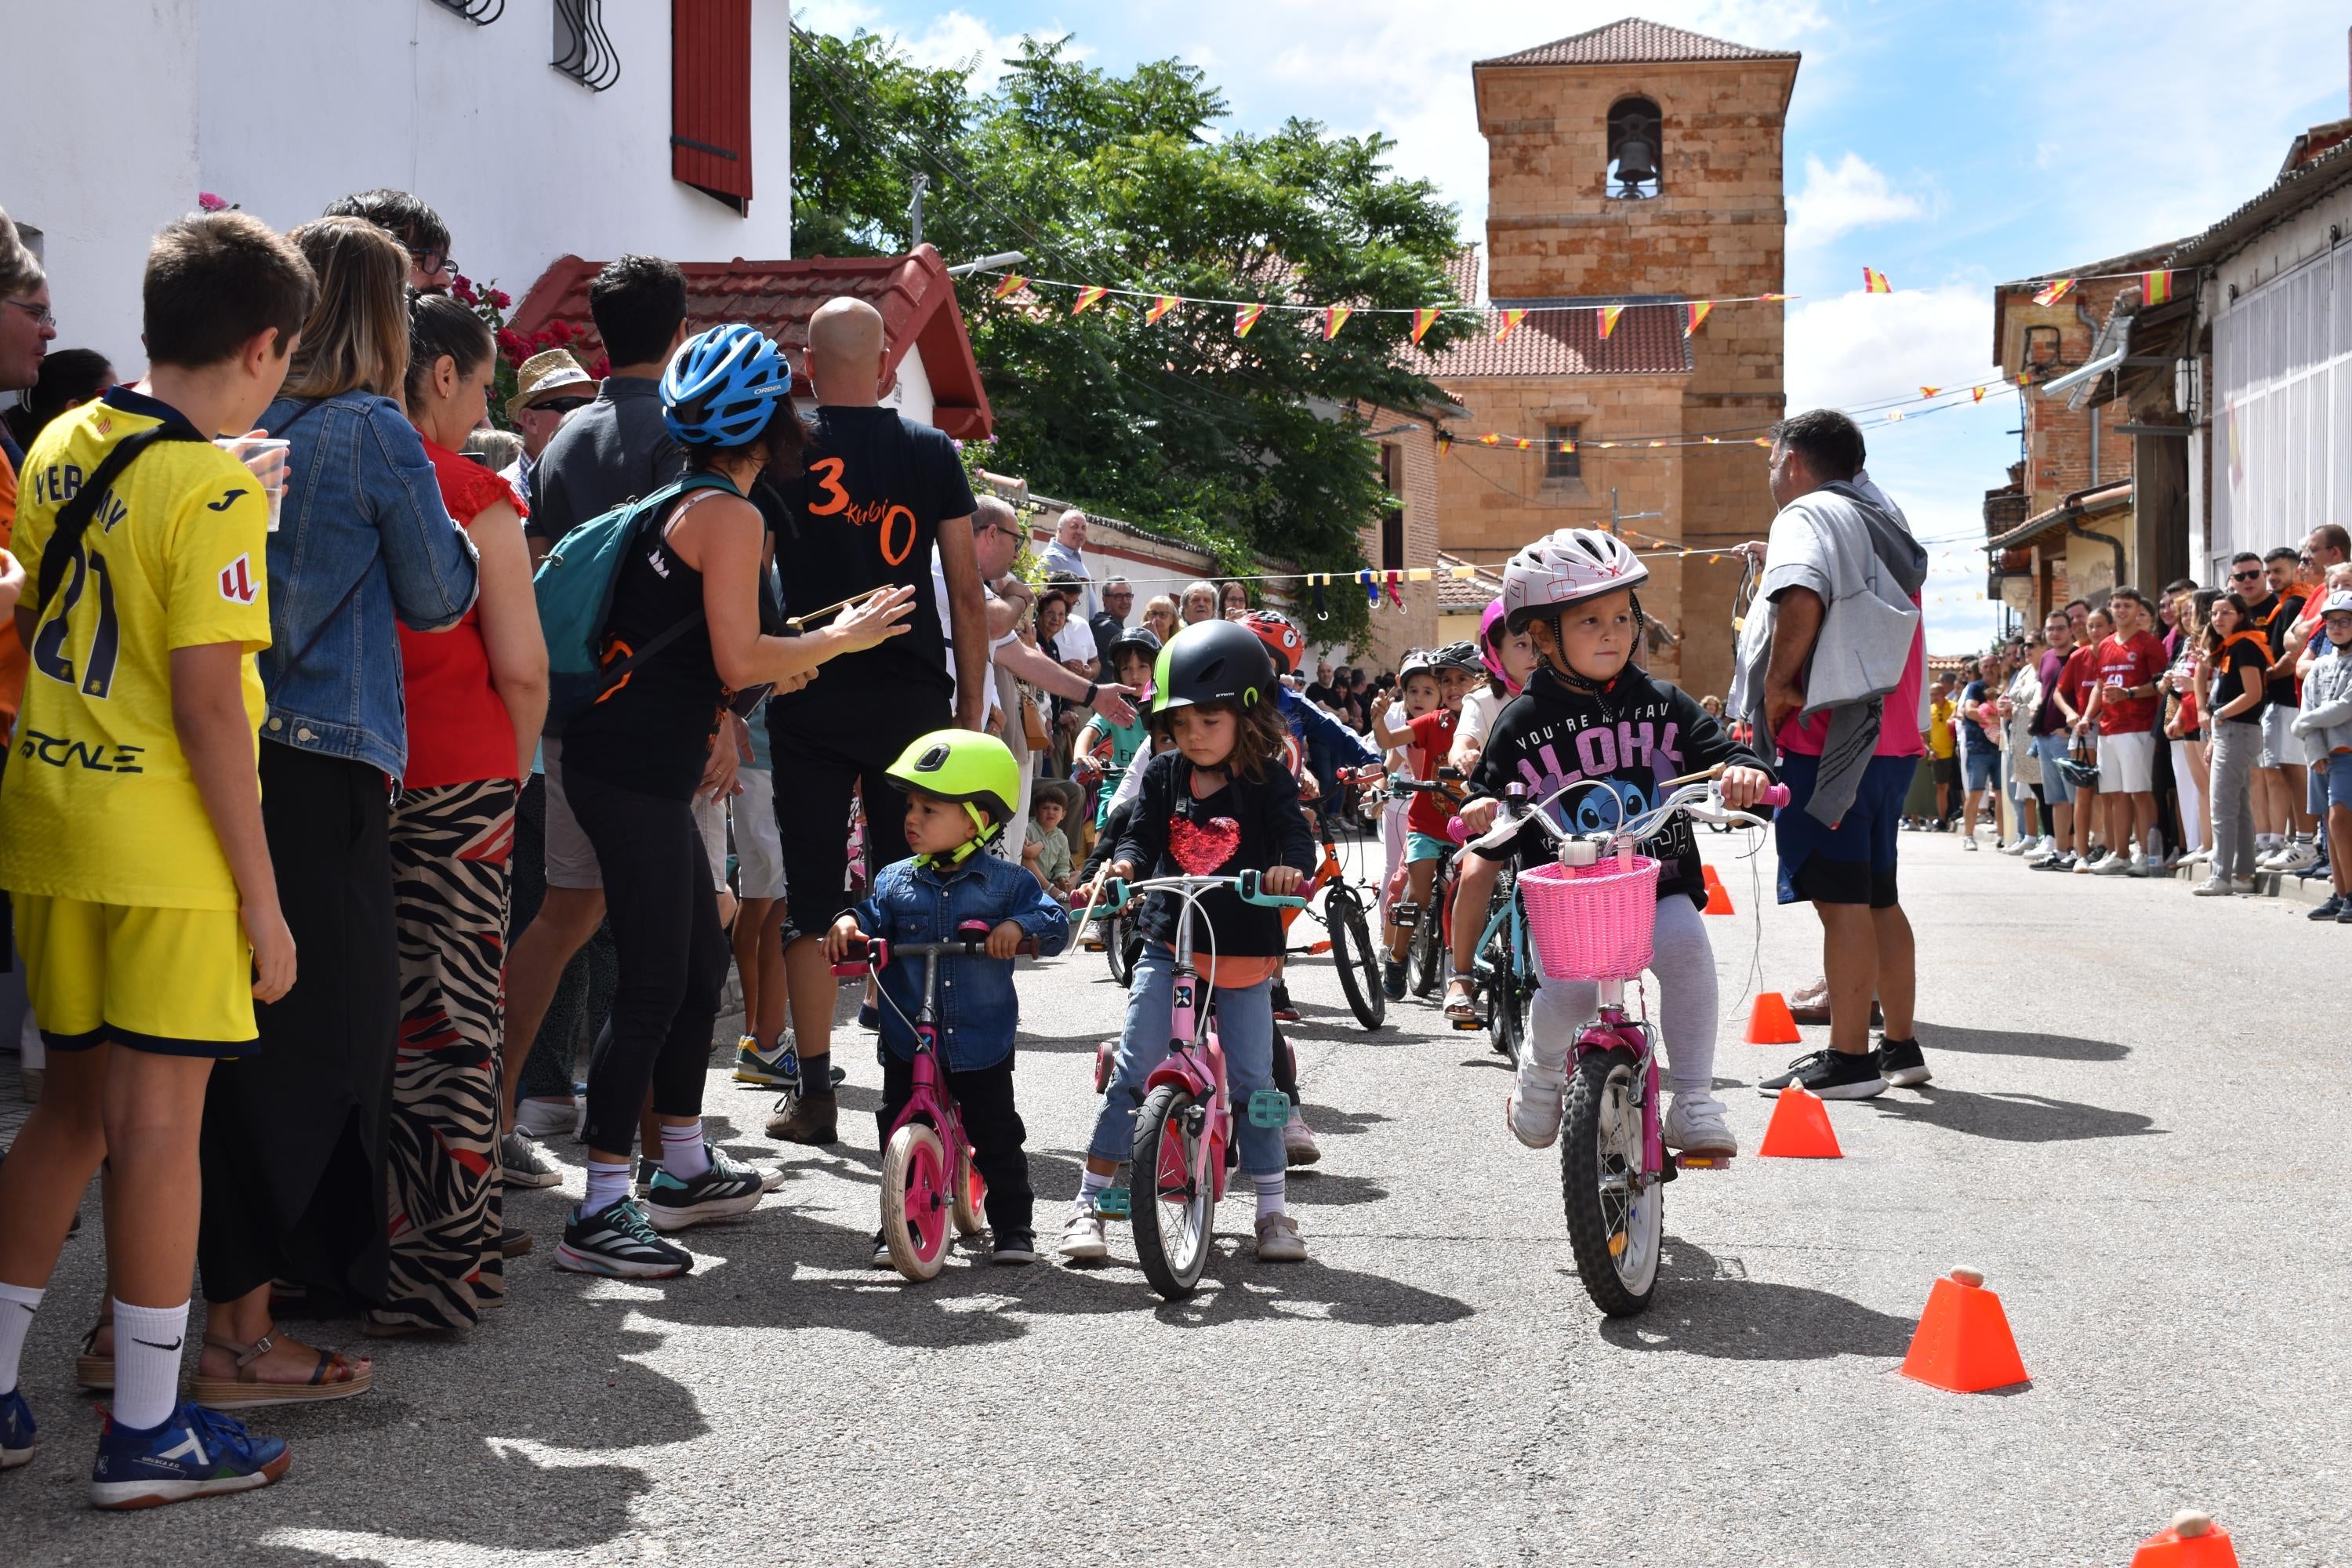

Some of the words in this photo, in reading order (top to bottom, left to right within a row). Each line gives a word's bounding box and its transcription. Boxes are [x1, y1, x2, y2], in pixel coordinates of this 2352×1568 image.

[754, 384, 782, 394] ORBEA
[36, 464, 128, 535] YERMY
[1288, 634, 1294, 644] 7
[1516, 714, 1588, 750] YOU'RE
[1635, 702, 1669, 720] FAV
